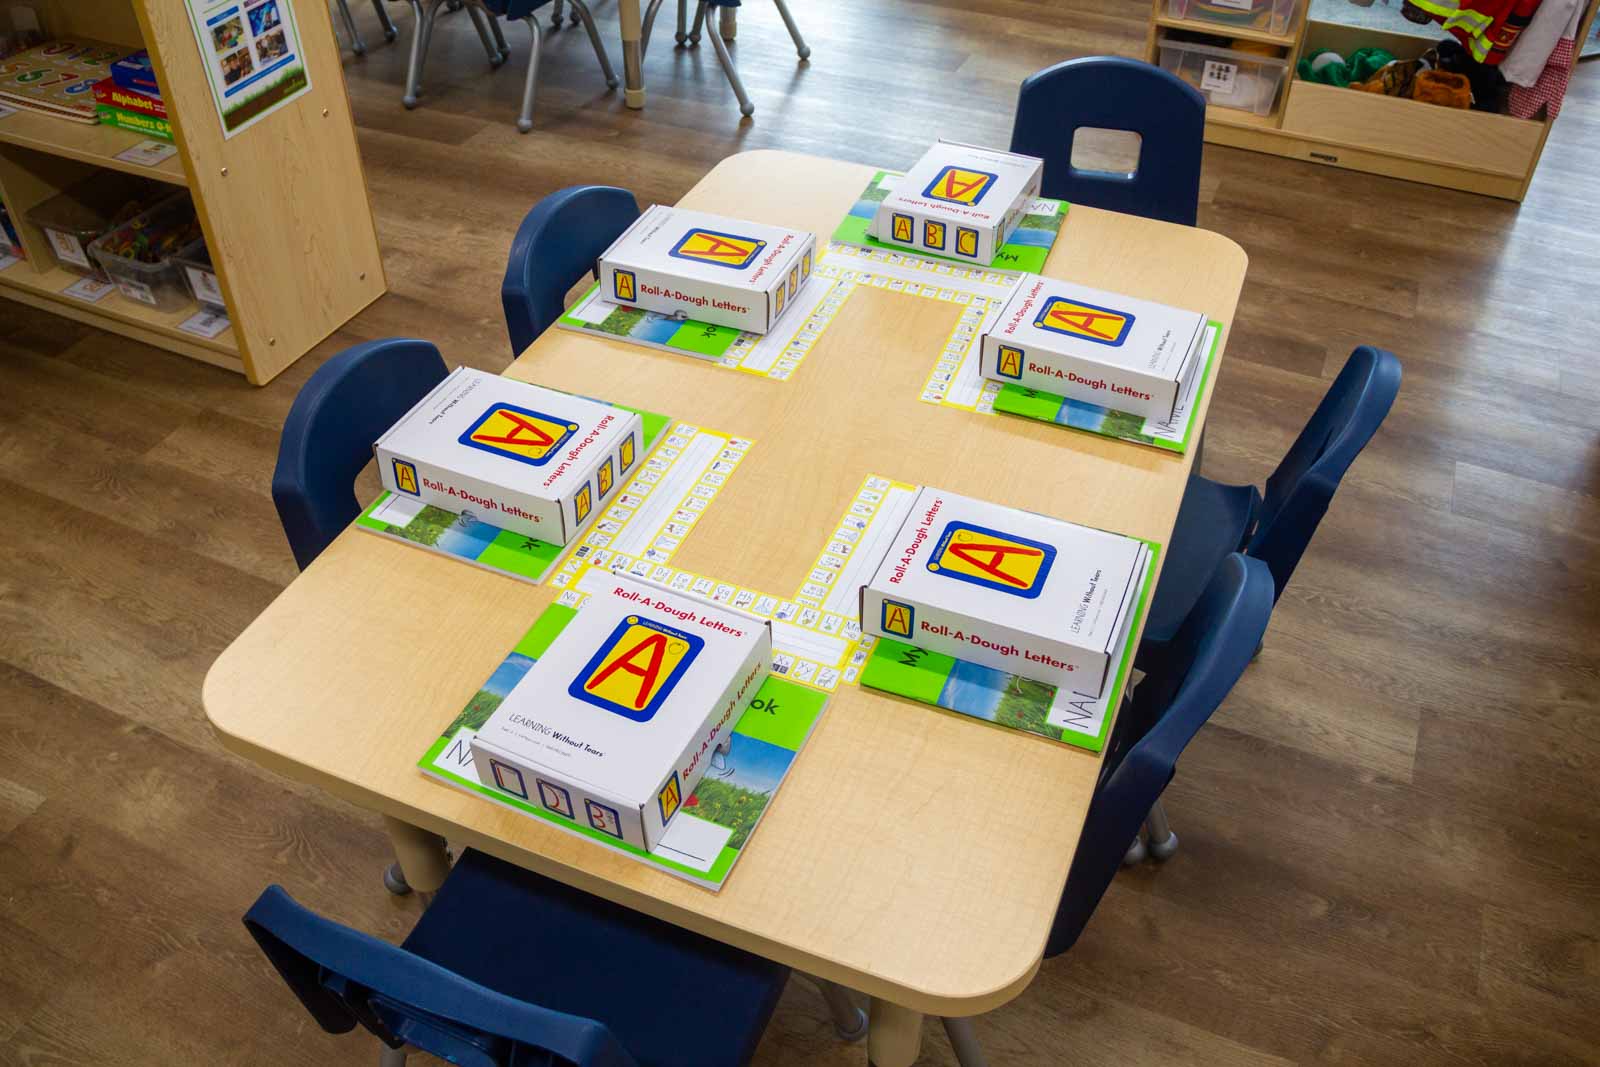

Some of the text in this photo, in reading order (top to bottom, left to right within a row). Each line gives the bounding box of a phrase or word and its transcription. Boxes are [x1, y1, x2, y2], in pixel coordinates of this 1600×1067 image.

[111, 92, 154, 110] Alphabet
[116, 112, 155, 129] Numbers
[945, 169, 988, 199] A
[679, 232, 750, 257] A
[895, 219, 910, 240] A
[927, 223, 938, 245] B
[959, 231, 973, 253] C
[619, 275, 633, 298] A
[640, 284, 747, 314] Roll-A-Dough Letters
[1004, 281, 1044, 335] Roll-A-Dough Letters
[1050, 310, 1125, 341] A
[1001, 352, 1018, 375] A
[1029, 362, 1151, 401] Roll-A-Dough Letters
[472, 410, 554, 447] A
[567, 415, 615, 460] Roll-A-Dough
[400, 466, 416, 492] A
[543, 462, 571, 487] Letters
[599, 466, 609, 493] B
[423, 478, 540, 523] Roll-A-Dough Letters
[579, 491, 589, 520] A
[890, 526, 928, 584] Roll-A-Dough
[926, 499, 943, 526] Letters
[948, 543, 1043, 588] A
[1083, 579, 1097, 604] Without
[612, 587, 743, 637] Roll-A-Dough Letters
[887, 607, 907, 634] A
[921, 620, 1074, 672] Roll-A-Dough Letters
[585, 633, 668, 709] A
[509, 712, 552, 735] LEARNING
[552, 731, 584, 749] Without
[584, 744, 605, 758] Tears
[682, 661, 762, 780] Roll-A-Dough Letters
[665, 786, 678, 820] A
